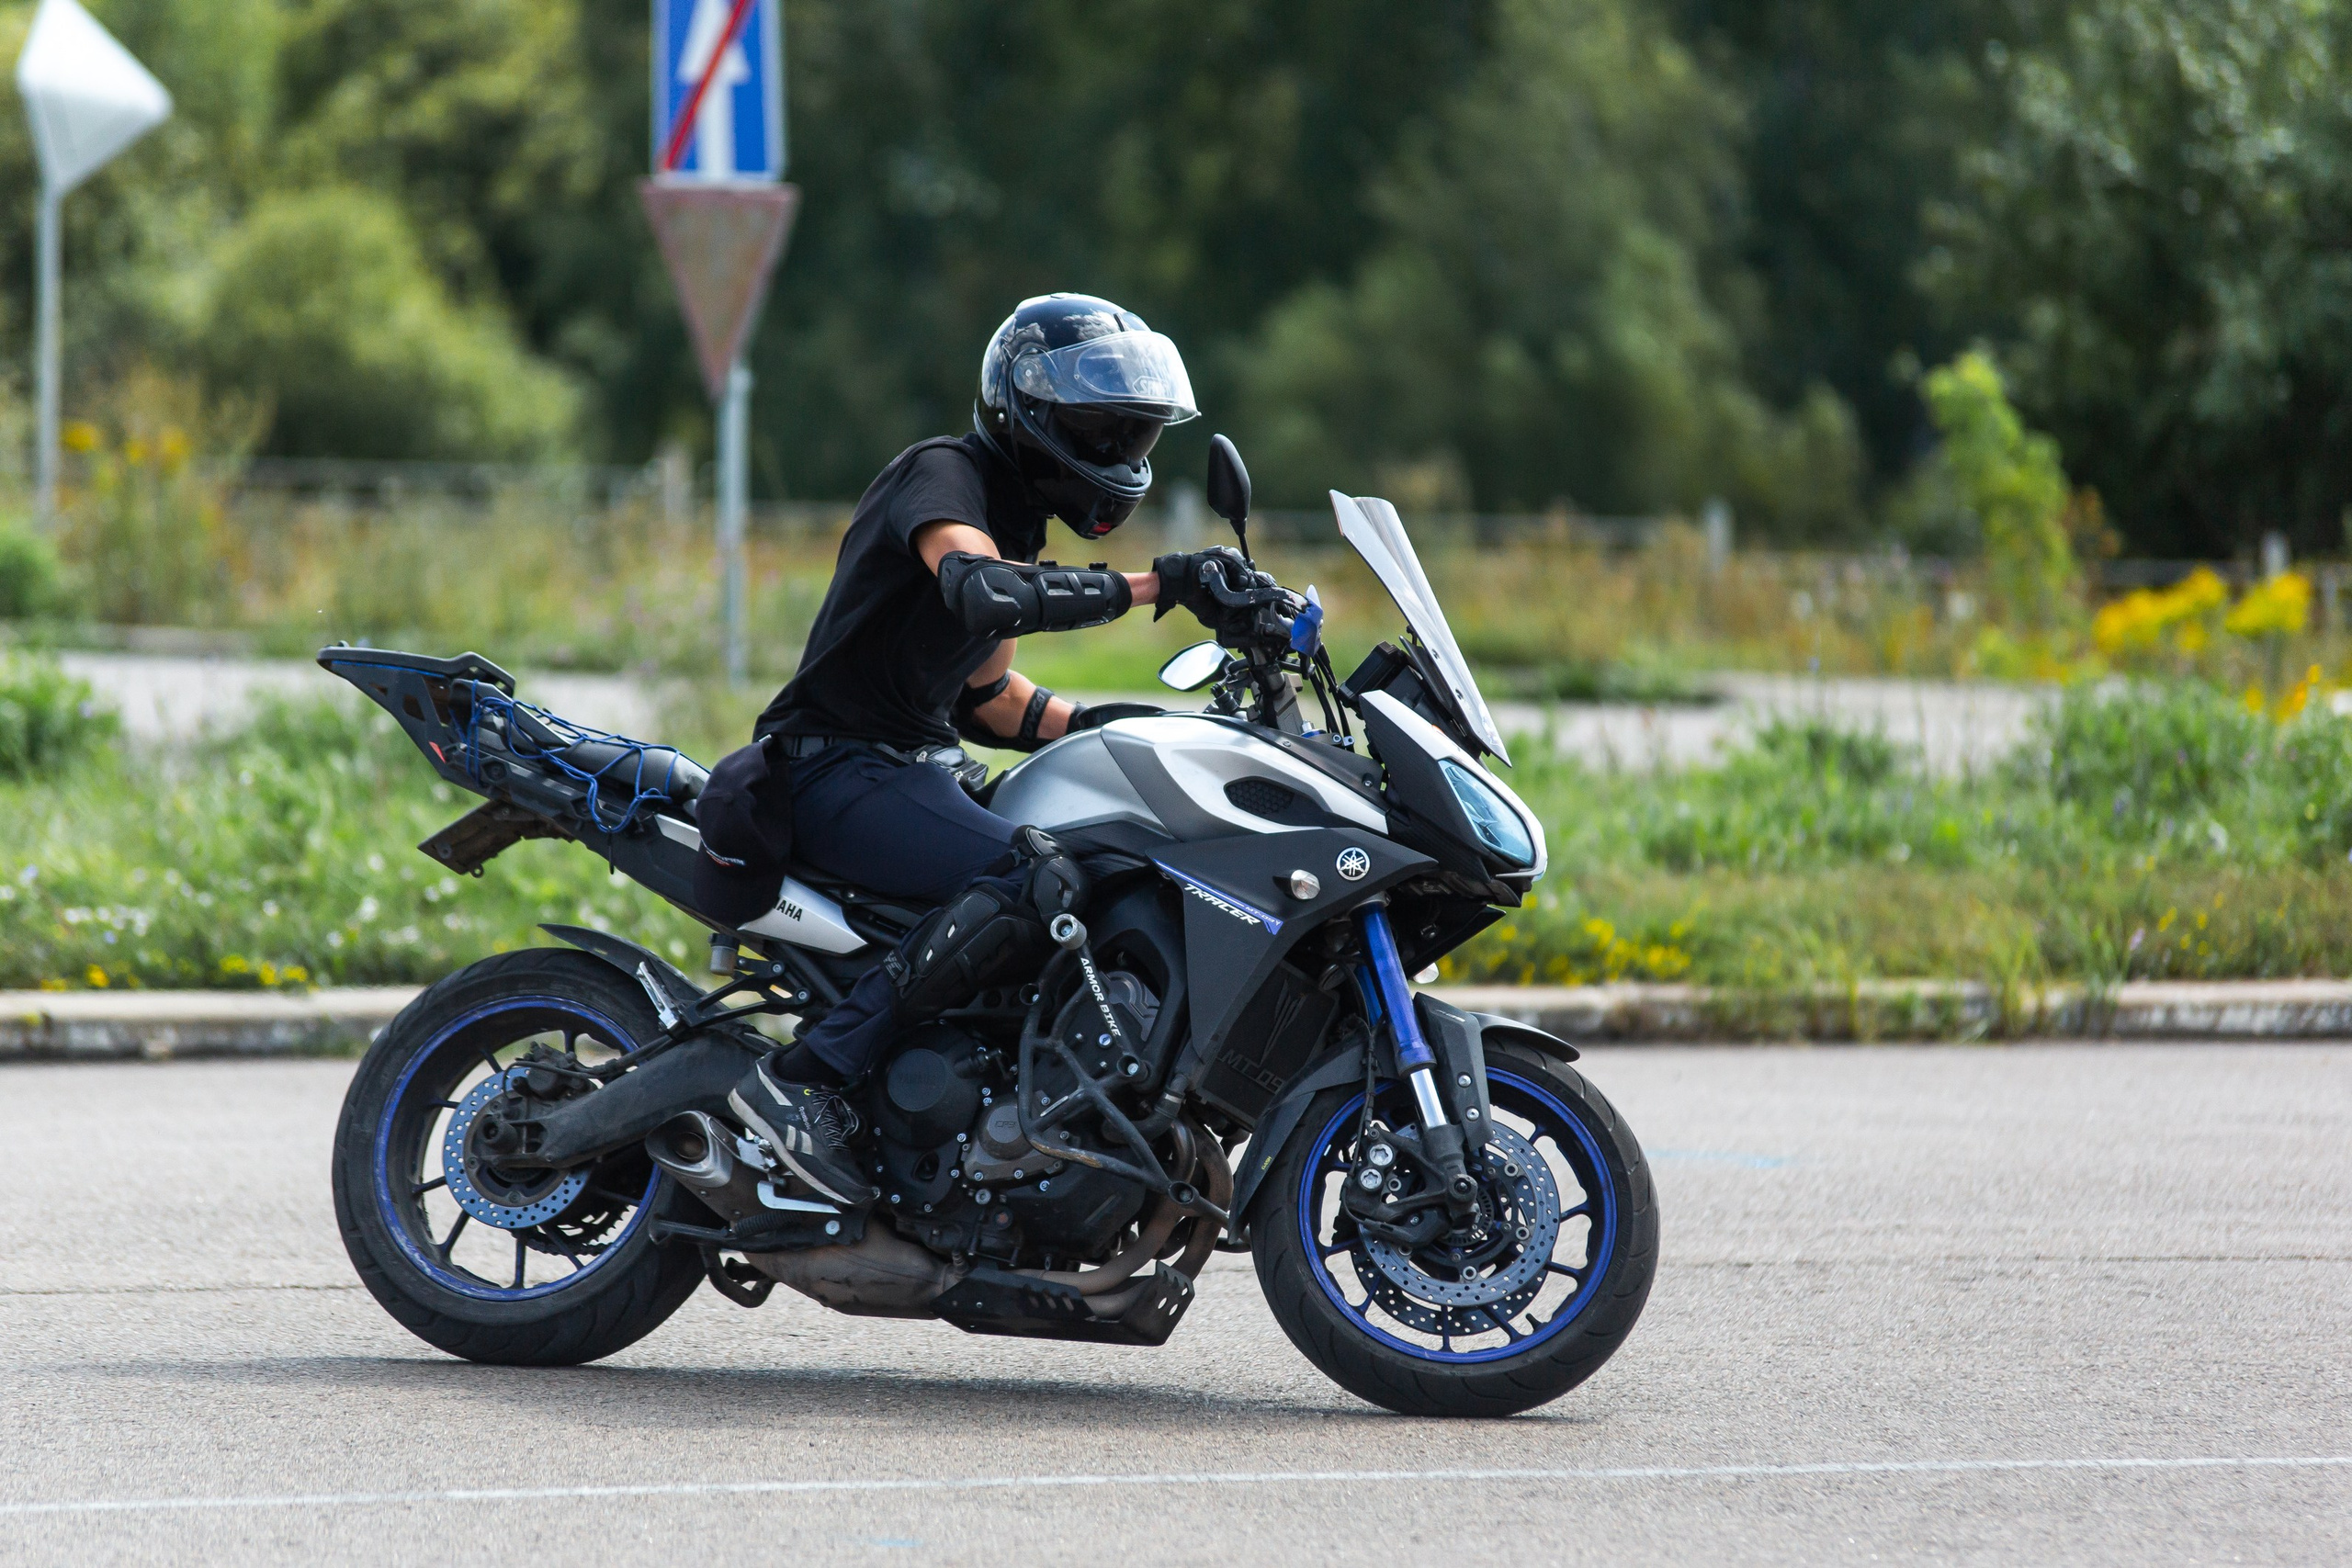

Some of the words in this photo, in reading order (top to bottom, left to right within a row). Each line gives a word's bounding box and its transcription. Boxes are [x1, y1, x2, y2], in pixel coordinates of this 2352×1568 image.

[774, 899, 803, 922] AHA
[1183, 883, 1261, 926] TRACER
[1080, 957, 1105, 1002] ARMOR
[1099, 1004, 1122, 1037] BIKE
[797, 1105, 811, 1131] Reebok
